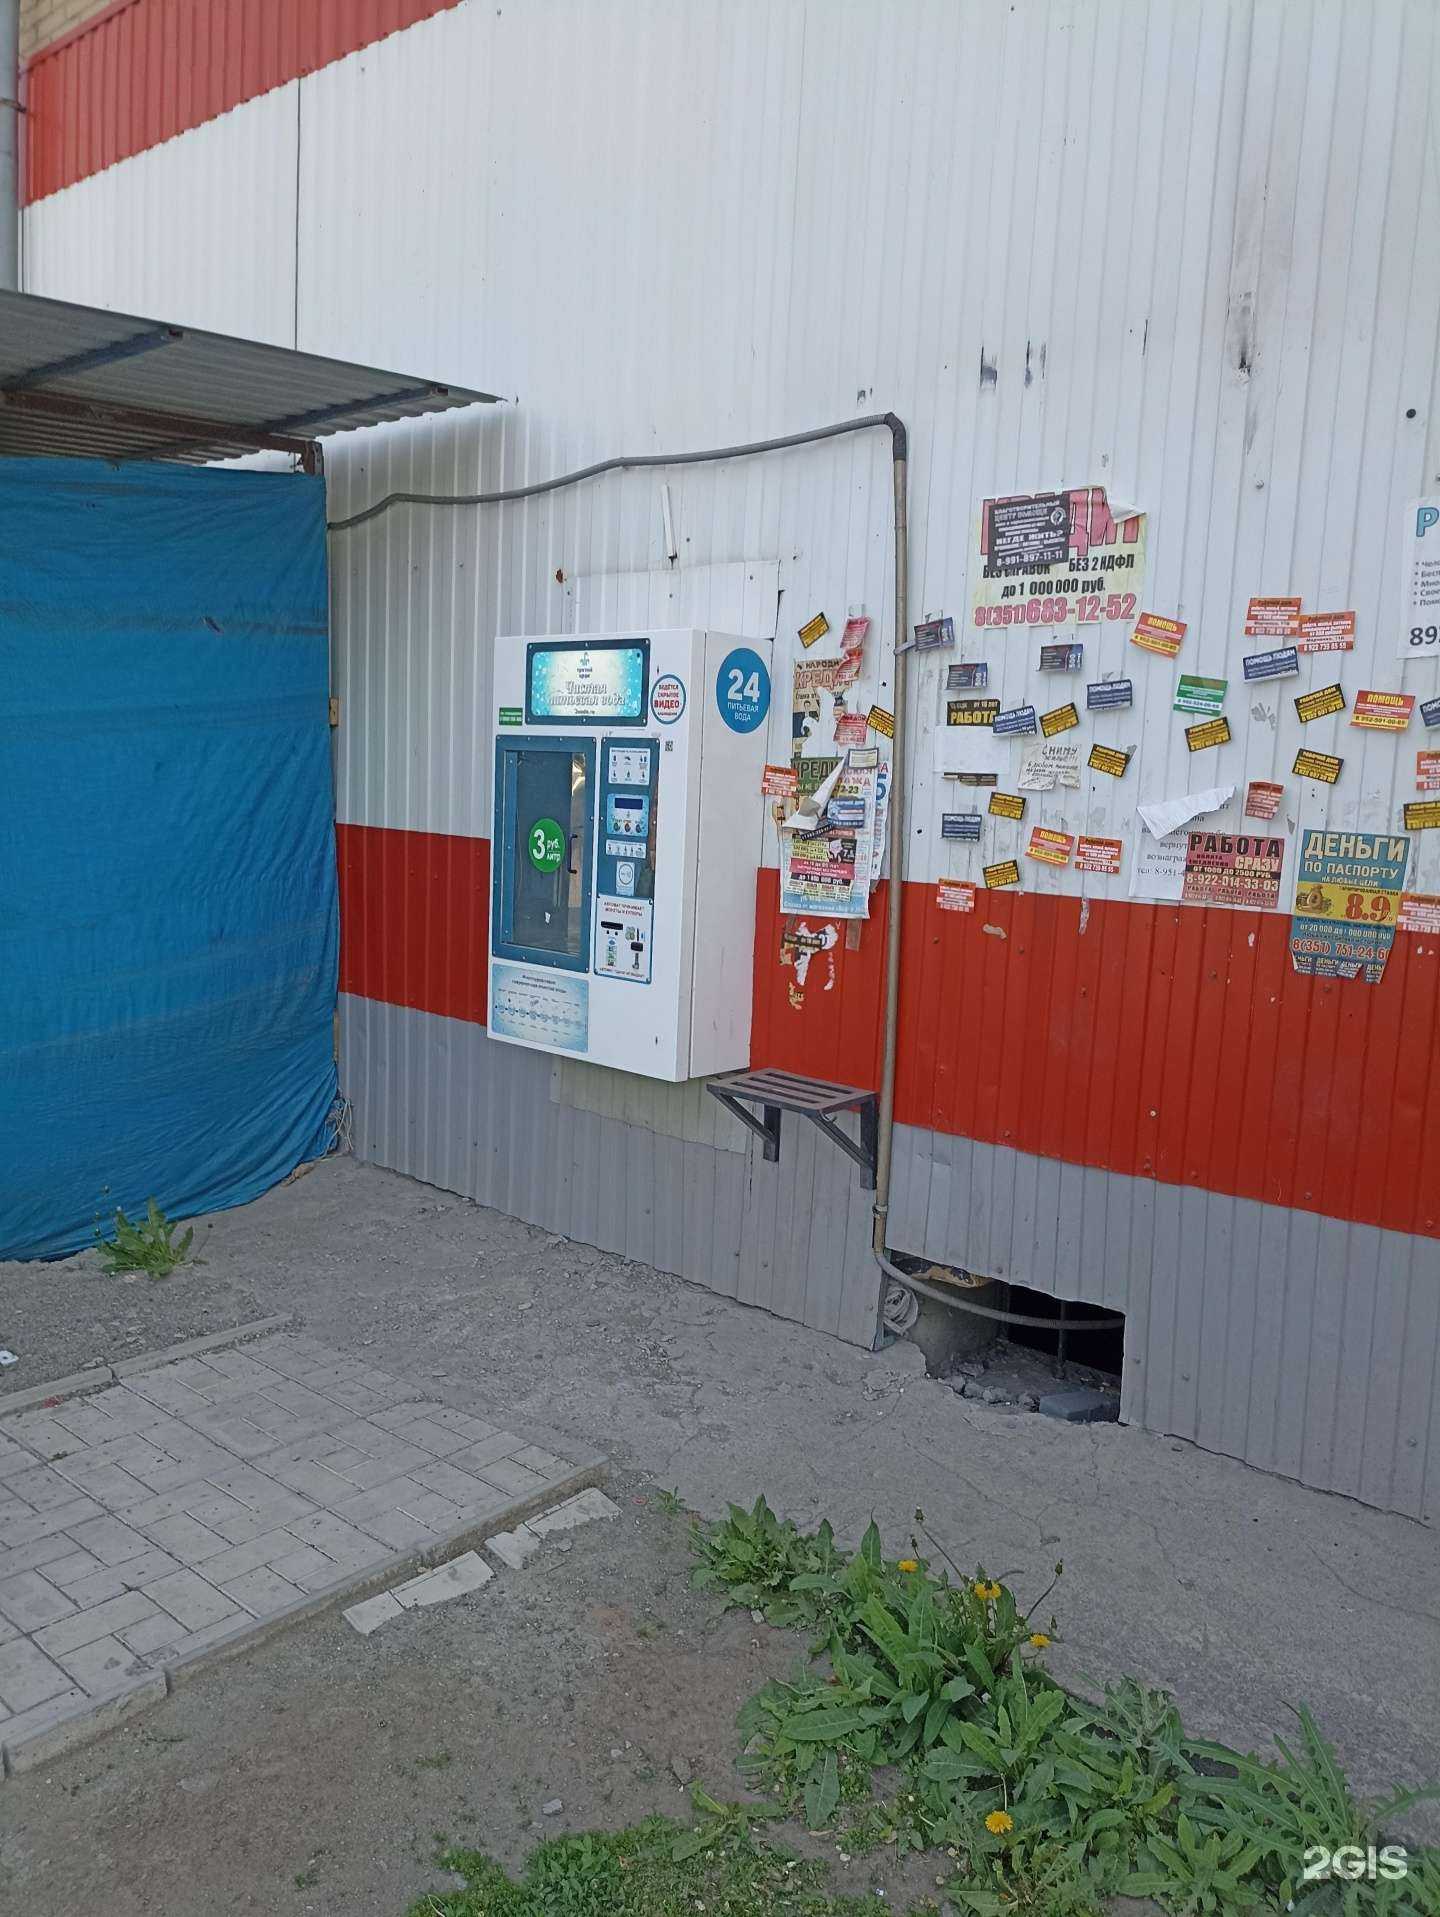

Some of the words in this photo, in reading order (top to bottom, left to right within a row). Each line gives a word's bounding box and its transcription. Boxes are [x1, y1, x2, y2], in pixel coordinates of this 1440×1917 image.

[1069, 558, 1089, 572] БЕЗ
[1092, 556, 1098, 571] 2
[1100, 553, 1135, 572] НДФЛ
[1001, 584, 1016, 599] до
[1019, 582, 1025, 597] 1
[1029, 580, 1053, 596] 000
[1055, 578, 1079, 594] 000
[1081, 576, 1106, 594] руб.
[974, 592, 1138, 627] 8(351)683-12-52
[727, 667, 761, 703] 24
[654, 699, 681, 710] ВИДЕО
[727, 701, 760, 713] ПИТЬЕВАЯ
[1367, 693, 1404, 706] ПОМОЩЬ
[734, 711, 752, 722] ВОДА
[532, 828, 546, 860] 3
[1189, 833, 1280, 858] РАБОТА
[1304, 832, 1406, 863] ДЕНЬГИ
[1234, 856, 1280, 872] СРАЗУ
[1235, 869, 1255, 877] 2500
[1304, 861, 1322, 873] ПО
[1327, 862, 1400, 880] ПАСПОРТУ
[1186, 873, 1279, 892] 8-922-014-33-03
[1292, 938, 1332, 955] 8(351)
